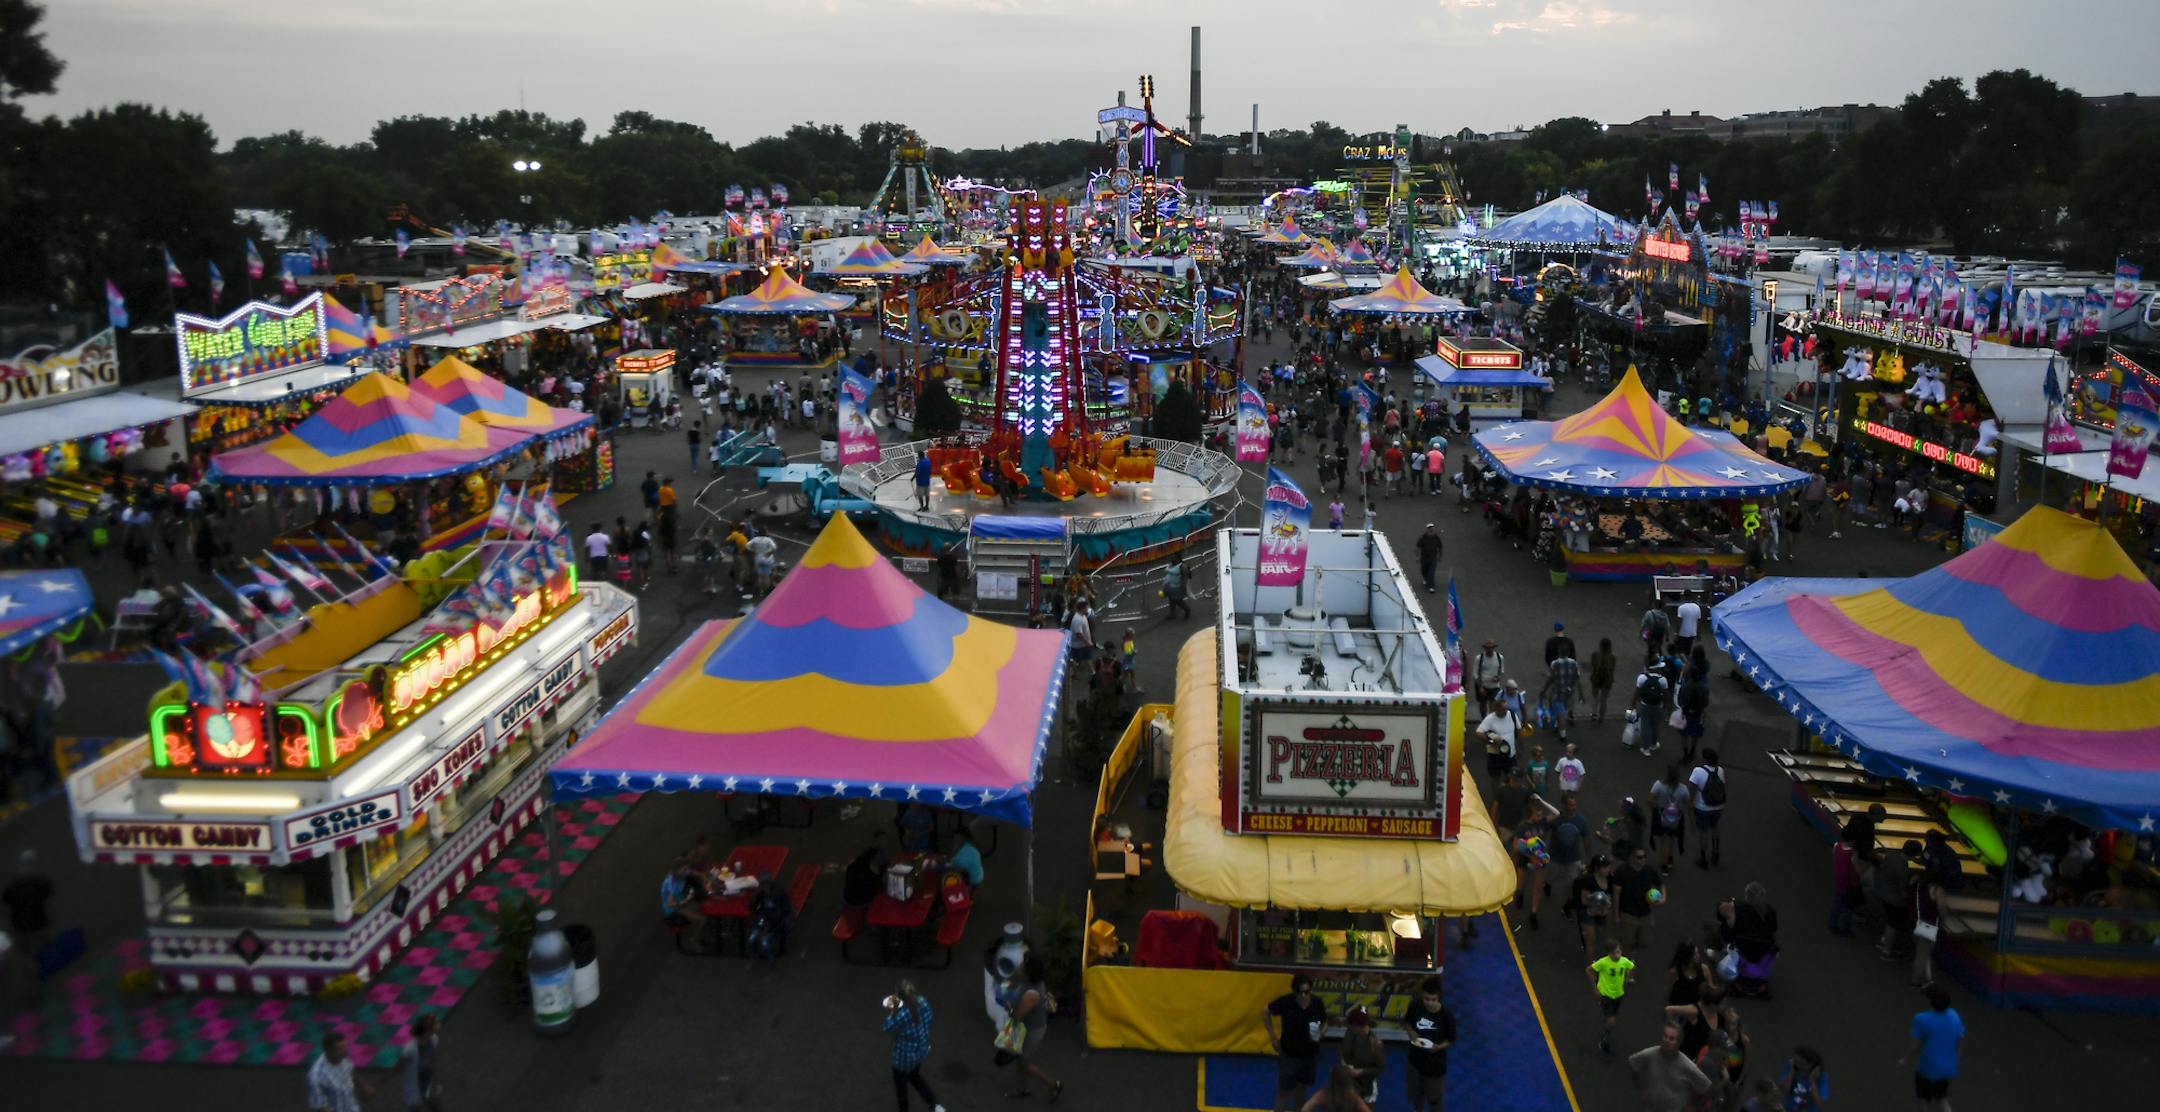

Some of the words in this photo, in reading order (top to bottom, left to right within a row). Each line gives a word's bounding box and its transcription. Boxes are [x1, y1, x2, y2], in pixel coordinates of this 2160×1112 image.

[186, 327, 245, 362] WATER
[1824, 311, 1887, 338] MACHINE
[1903, 327, 1944, 349] GUNS
[1471, 356, 1511, 365] TICKETS
[0, 362, 116, 405] OWLING
[1266, 484, 1309, 509] MIDWAY
[1260, 563, 1291, 574] FAIR
[500, 685, 542, 731] COTTON
[544, 657, 575, 690] CANDY
[413, 770, 441, 803] SNO
[444, 732, 484, 769] KONES
[1267, 735, 1419, 787] PIZZERIA
[296, 808, 393, 844] DRINKS
[309, 800, 378, 827] COLD
[1250, 815, 1293, 830] CHEESE
[1306, 817, 1369, 833] PEPPERONI
[1381, 819, 1433, 835] SAUSAGE
[101, 823, 184, 847] COTTON
[192, 825, 262, 847] CANDY
[1311, 978, 1368, 991] imon's
